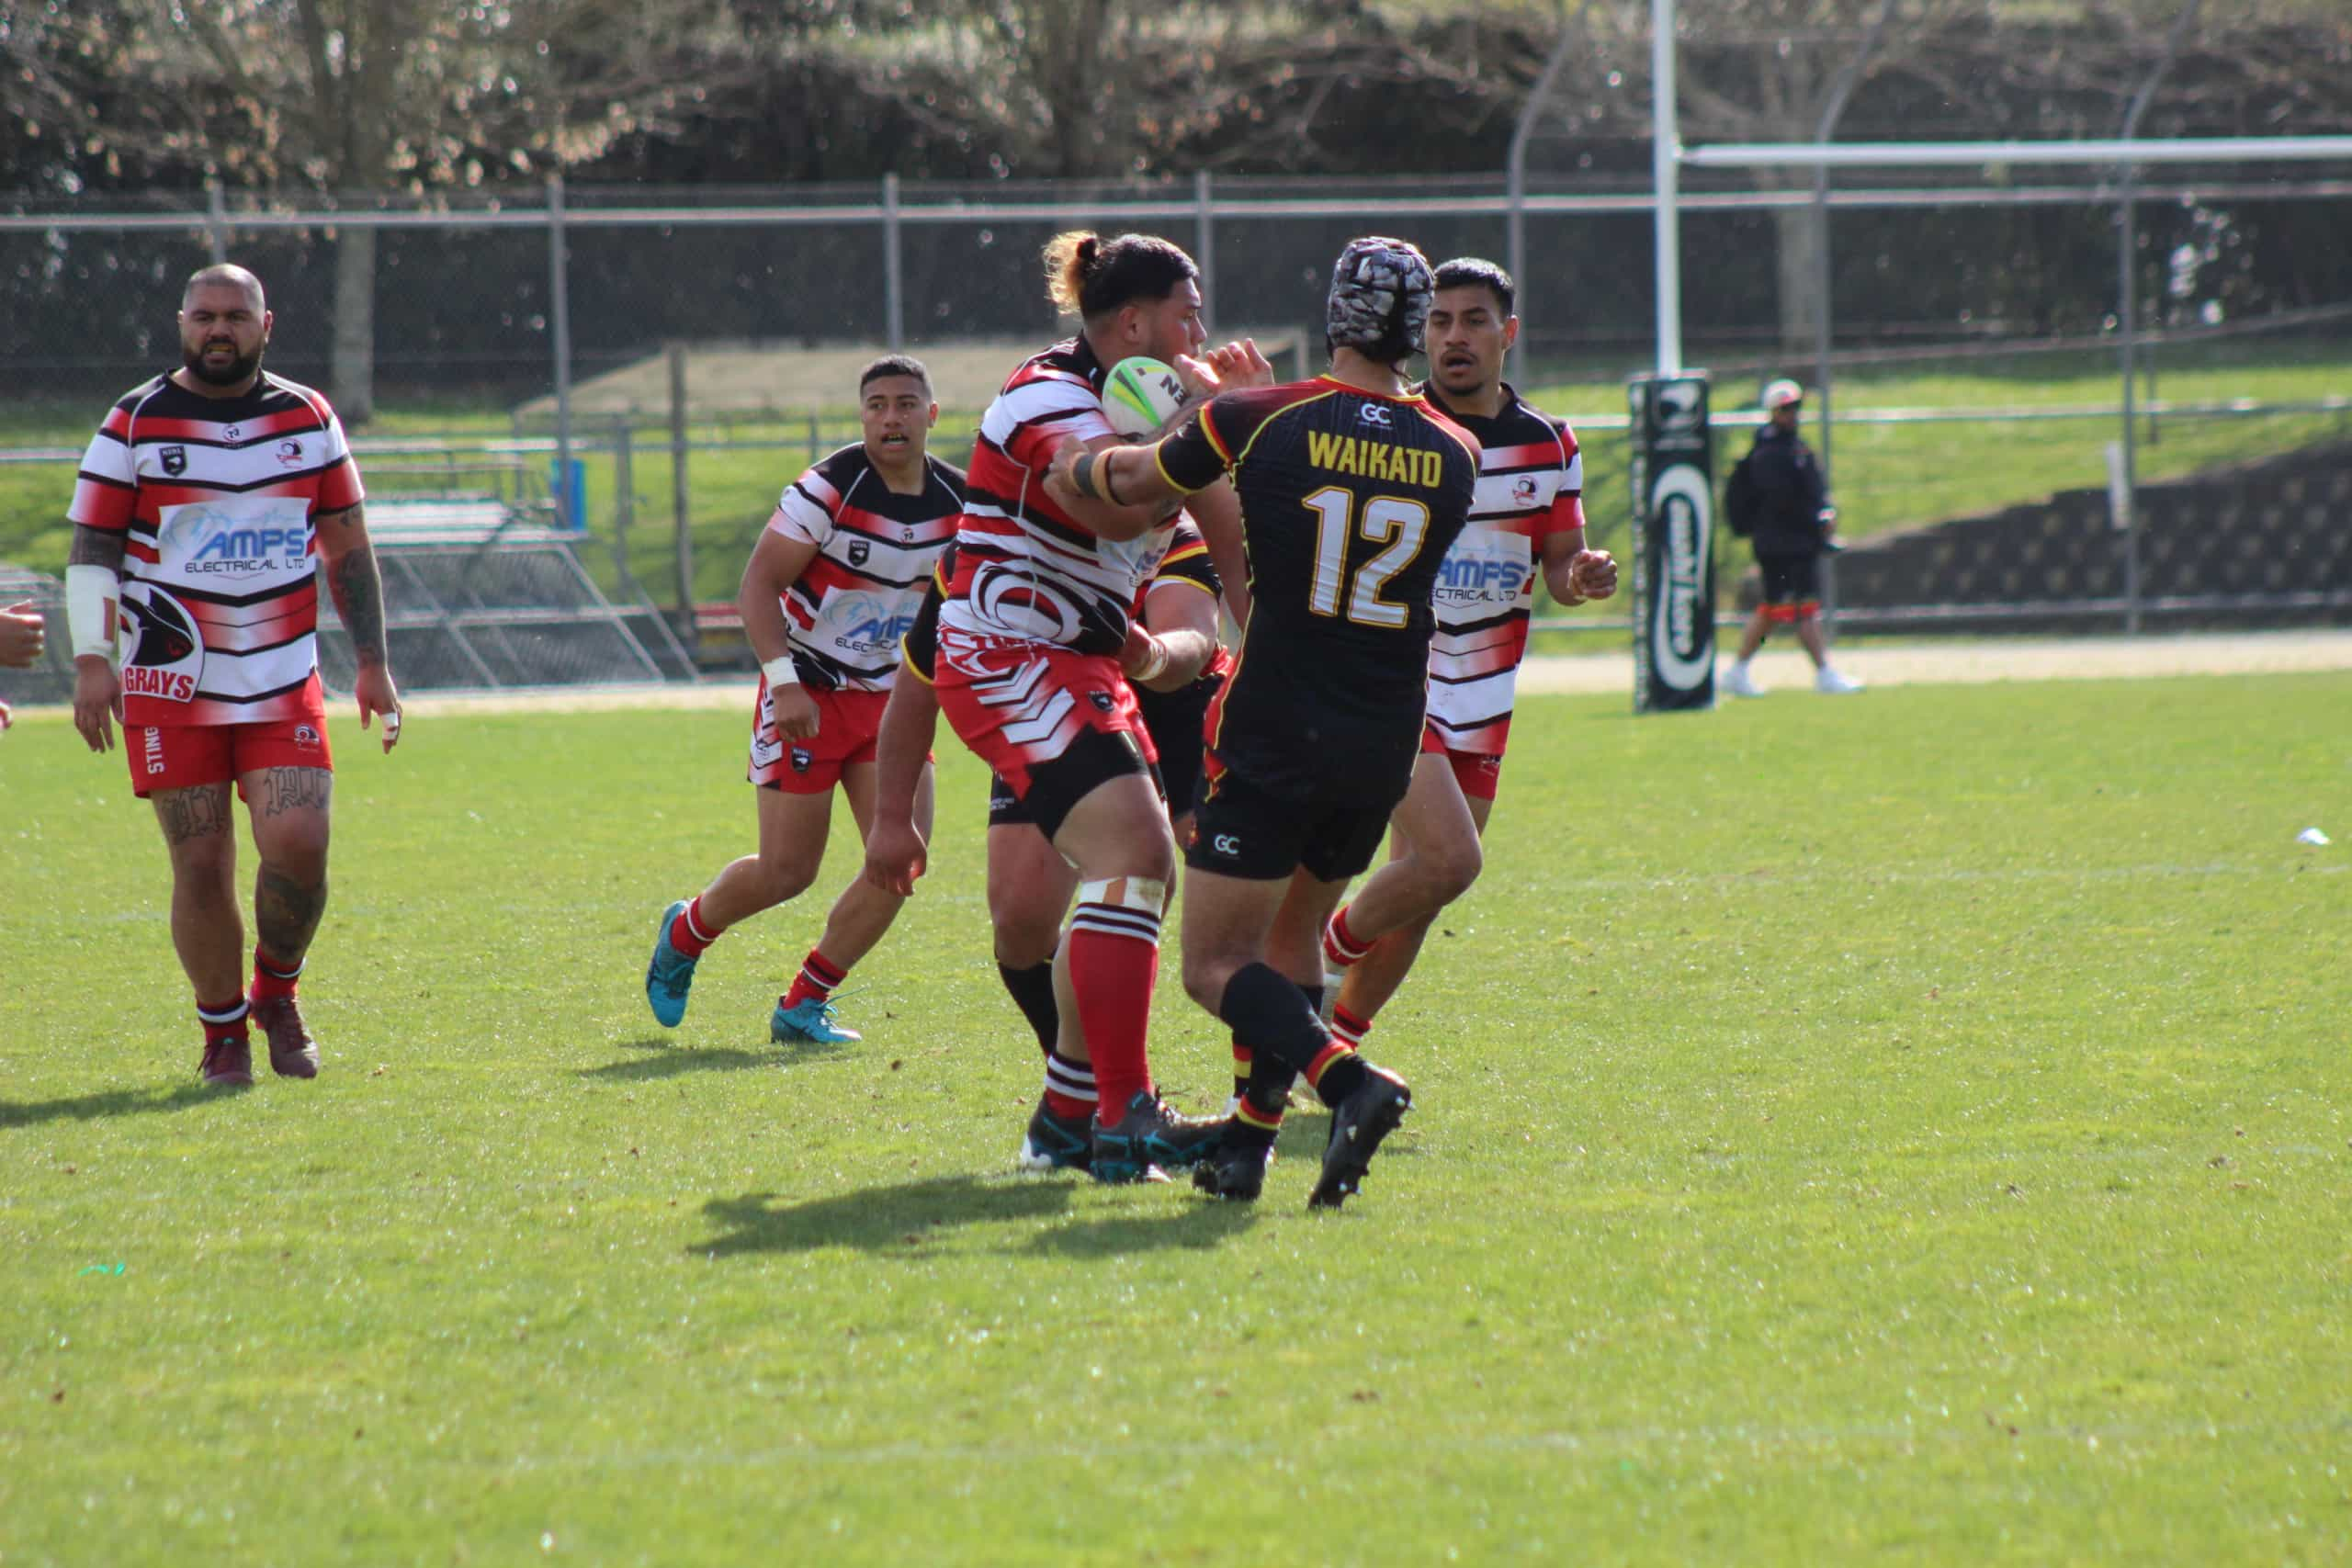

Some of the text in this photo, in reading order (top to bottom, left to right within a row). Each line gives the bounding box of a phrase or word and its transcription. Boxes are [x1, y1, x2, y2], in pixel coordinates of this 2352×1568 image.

[1362, 403, 1391, 424] GC
[1308, 430, 1442, 489] WAIKATO
[193, 528, 306, 559] AMPS
[1301, 485, 1430, 629] 12
[185, 558, 305, 573] ELECTRICAL LTD
[125, 666, 194, 701] GRAYS
[144, 726, 165, 775] STING
[1215, 834, 1240, 855] GC
